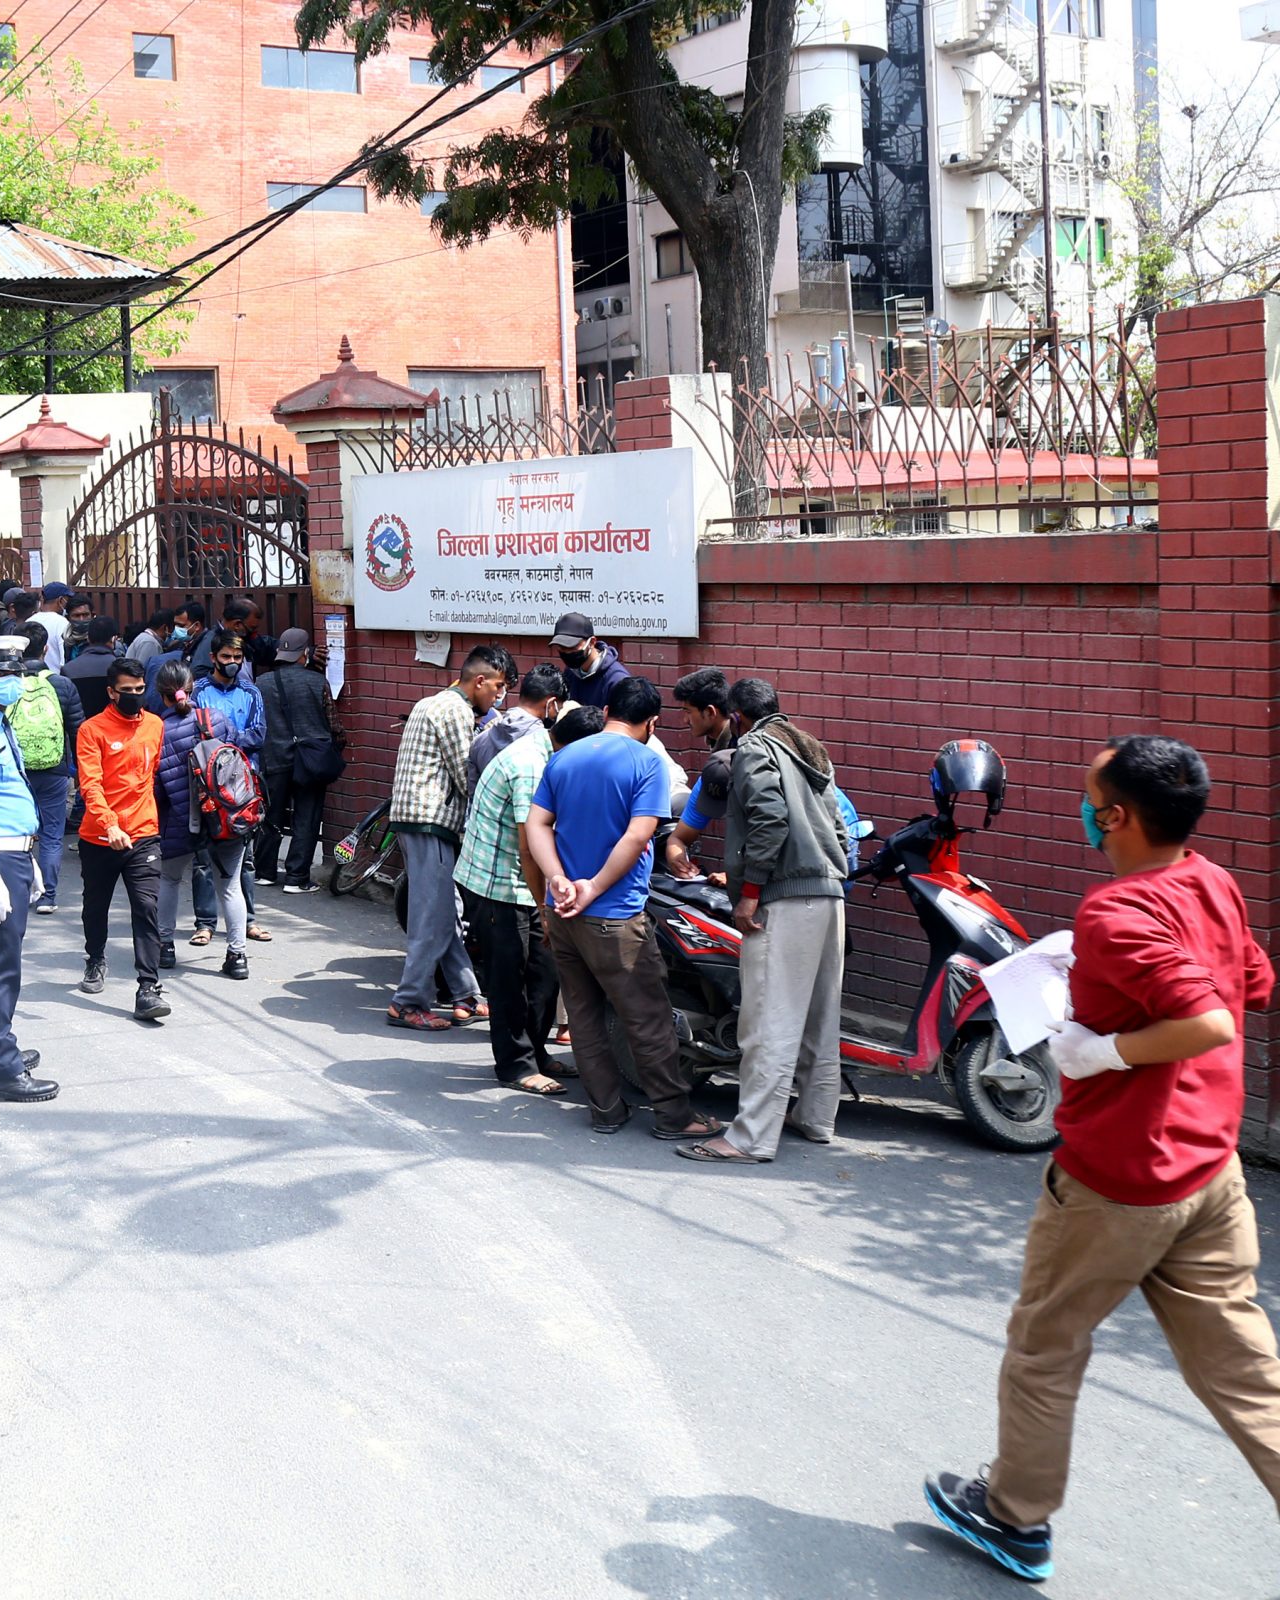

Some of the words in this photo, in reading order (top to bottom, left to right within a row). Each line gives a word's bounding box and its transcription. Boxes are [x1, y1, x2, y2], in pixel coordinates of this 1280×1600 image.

[508, 472, 529, 486] नेपाल
[531, 471, 560, 485] सरकार
[496, 496, 515, 523] गृह
[519, 493, 575, 515] मन्त्रालय
[437, 528, 490, 557] जिल्ला
[494, 531, 559, 558] प्रशासन
[564, 522, 651, 554] कार्यालय
[569, 565, 594, 581] नेपाल
[429, 609, 450, 623] E-mail:
[539, 612, 557, 625] Web:
